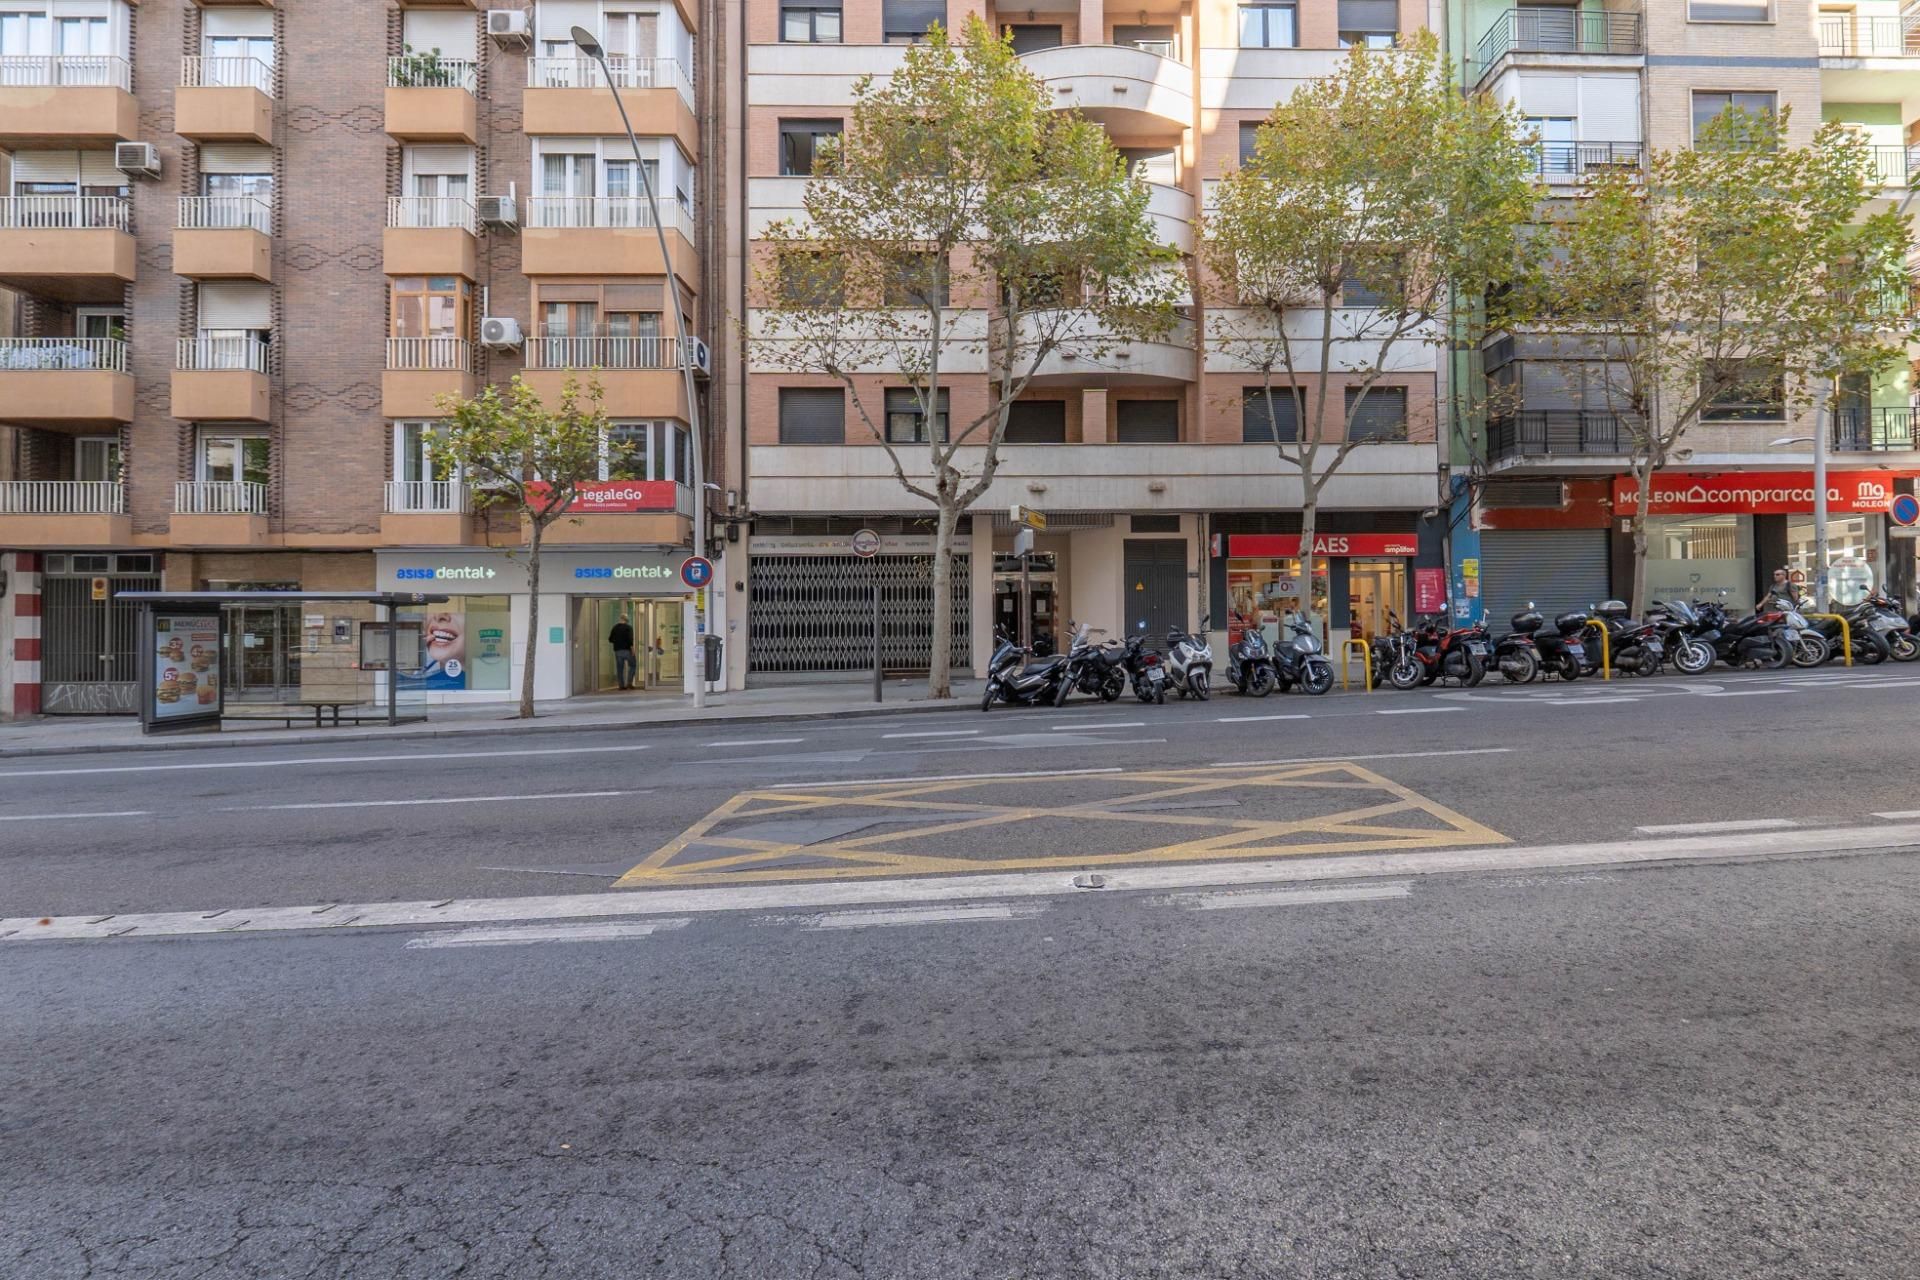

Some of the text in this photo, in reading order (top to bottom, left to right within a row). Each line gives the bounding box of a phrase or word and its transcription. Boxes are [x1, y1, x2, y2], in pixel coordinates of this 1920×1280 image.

[1707, 489, 1843, 508] comprarcaa.
[1312, 537, 1349, 553] AES
[396, 568, 434, 579] asisa
[575, 568, 612, 578] asisa
